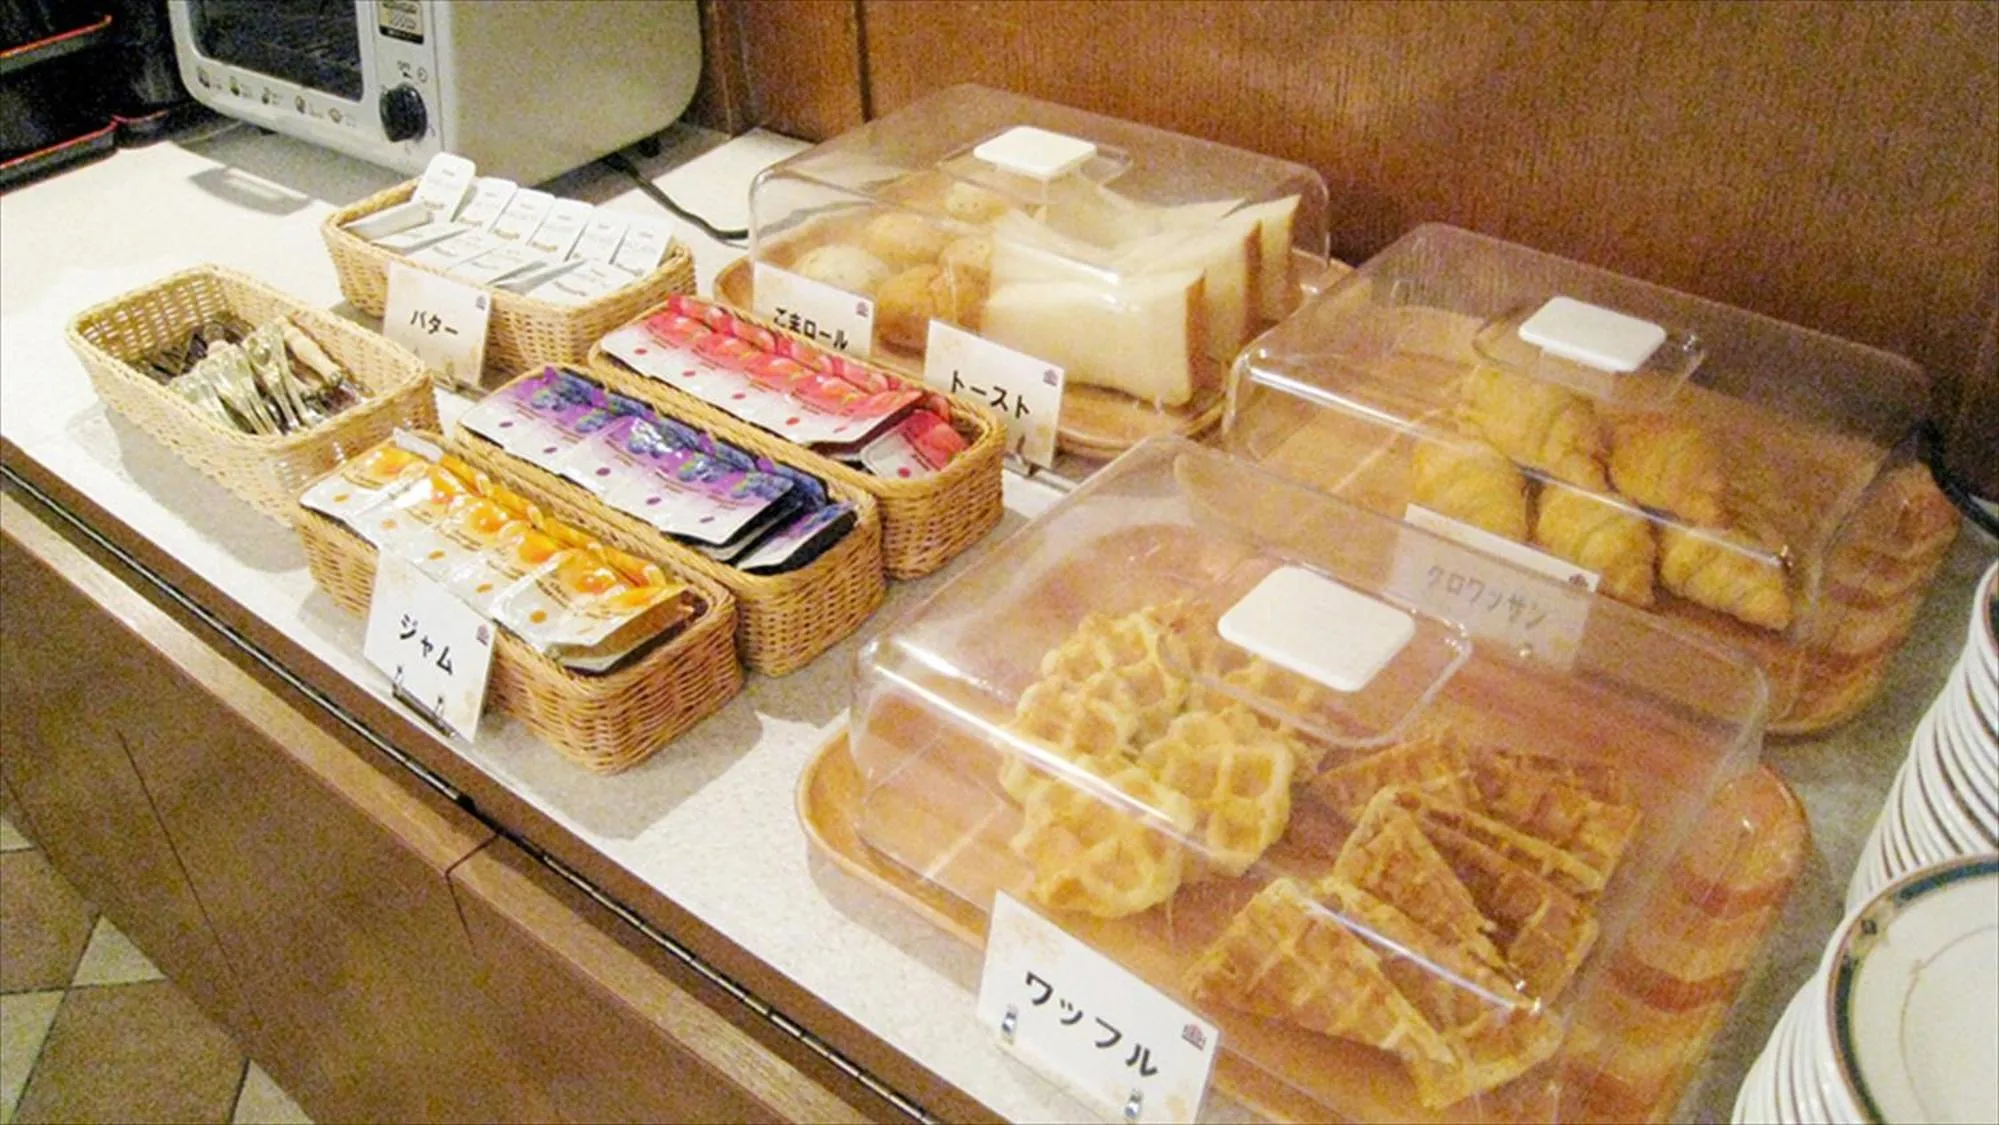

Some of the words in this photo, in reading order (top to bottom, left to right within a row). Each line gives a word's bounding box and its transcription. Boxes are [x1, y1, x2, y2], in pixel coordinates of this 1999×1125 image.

[410, 310, 459, 335] バター
[951, 369, 1030, 419] トースト
[400, 613, 453, 676] ジャム
[1025, 971, 1159, 1077] ワッフル
